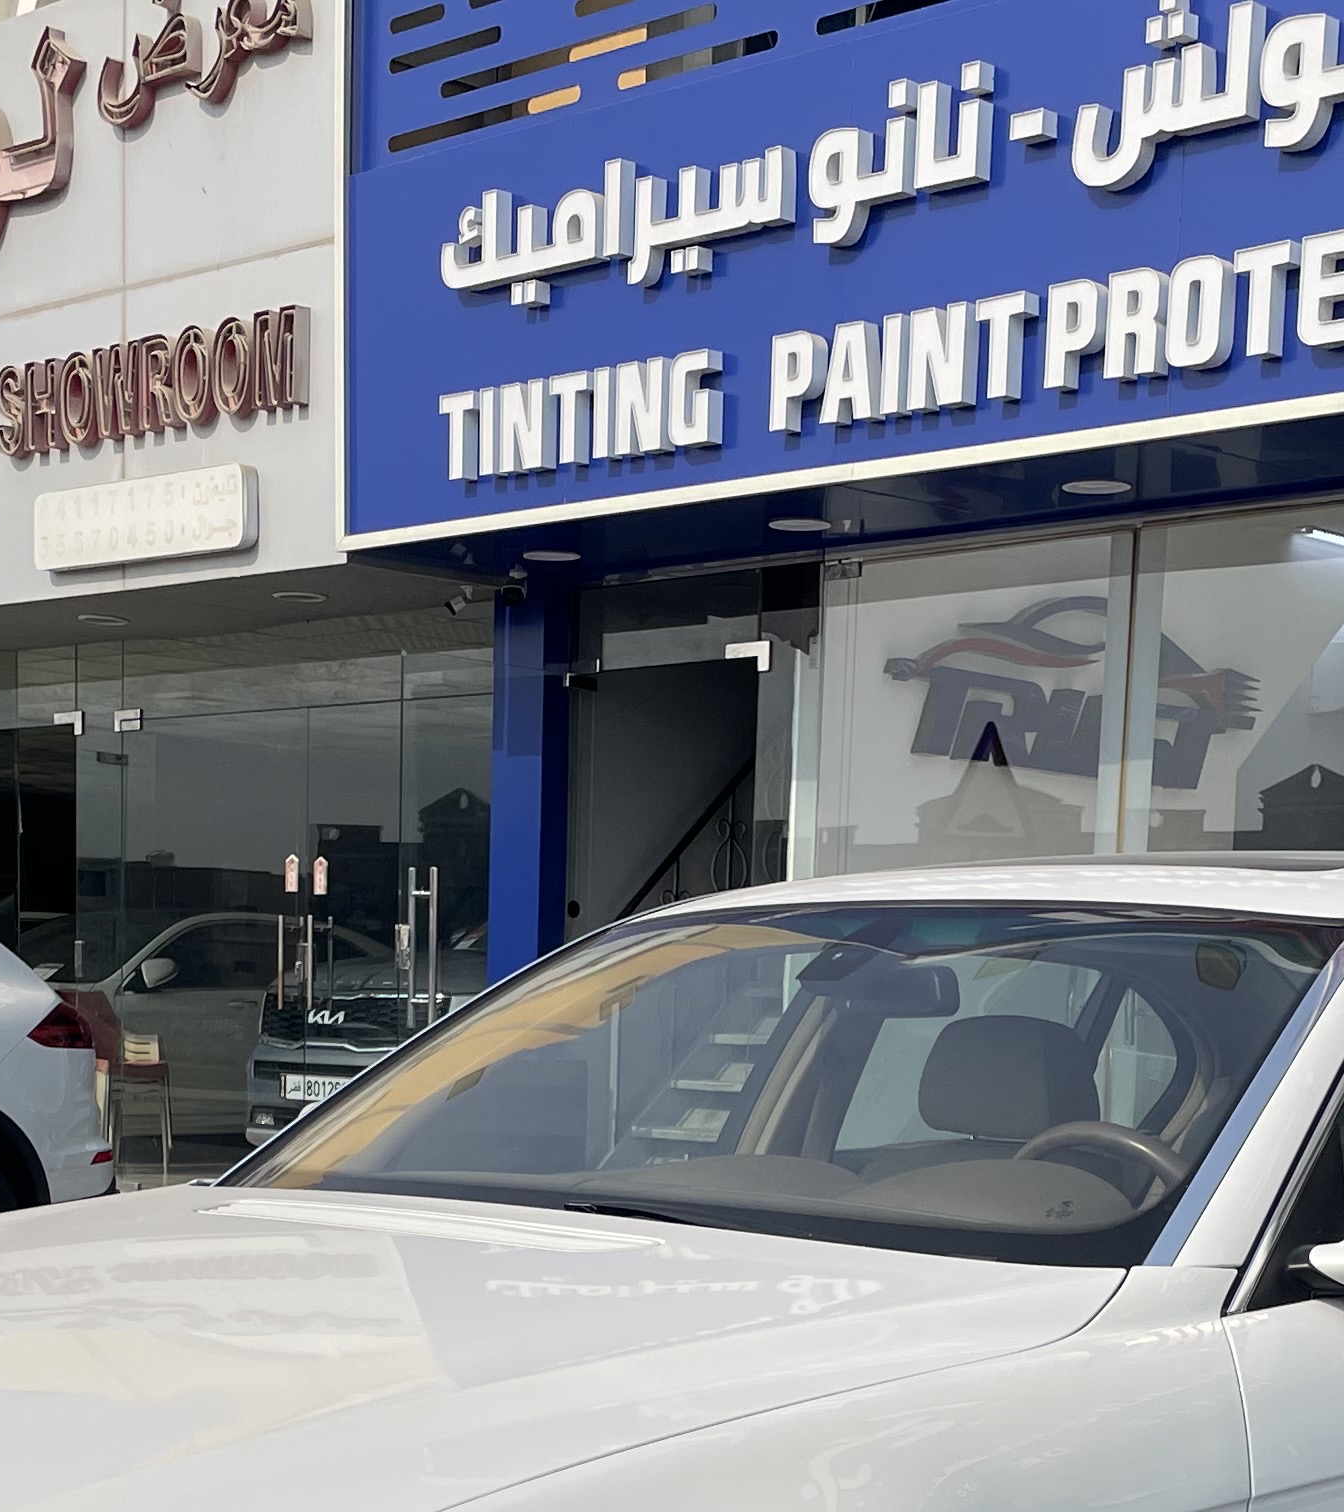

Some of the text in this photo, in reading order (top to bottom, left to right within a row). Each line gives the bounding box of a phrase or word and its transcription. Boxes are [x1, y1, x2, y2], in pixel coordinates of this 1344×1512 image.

[440, 144, 799, 310] سيراميك
[808, 58, 996, 248] نانو
[438, 347, 725, 483] TINTING
[768, 289, 1041, 435] PAINT
[306, 1079, 346, 1099] 8012
